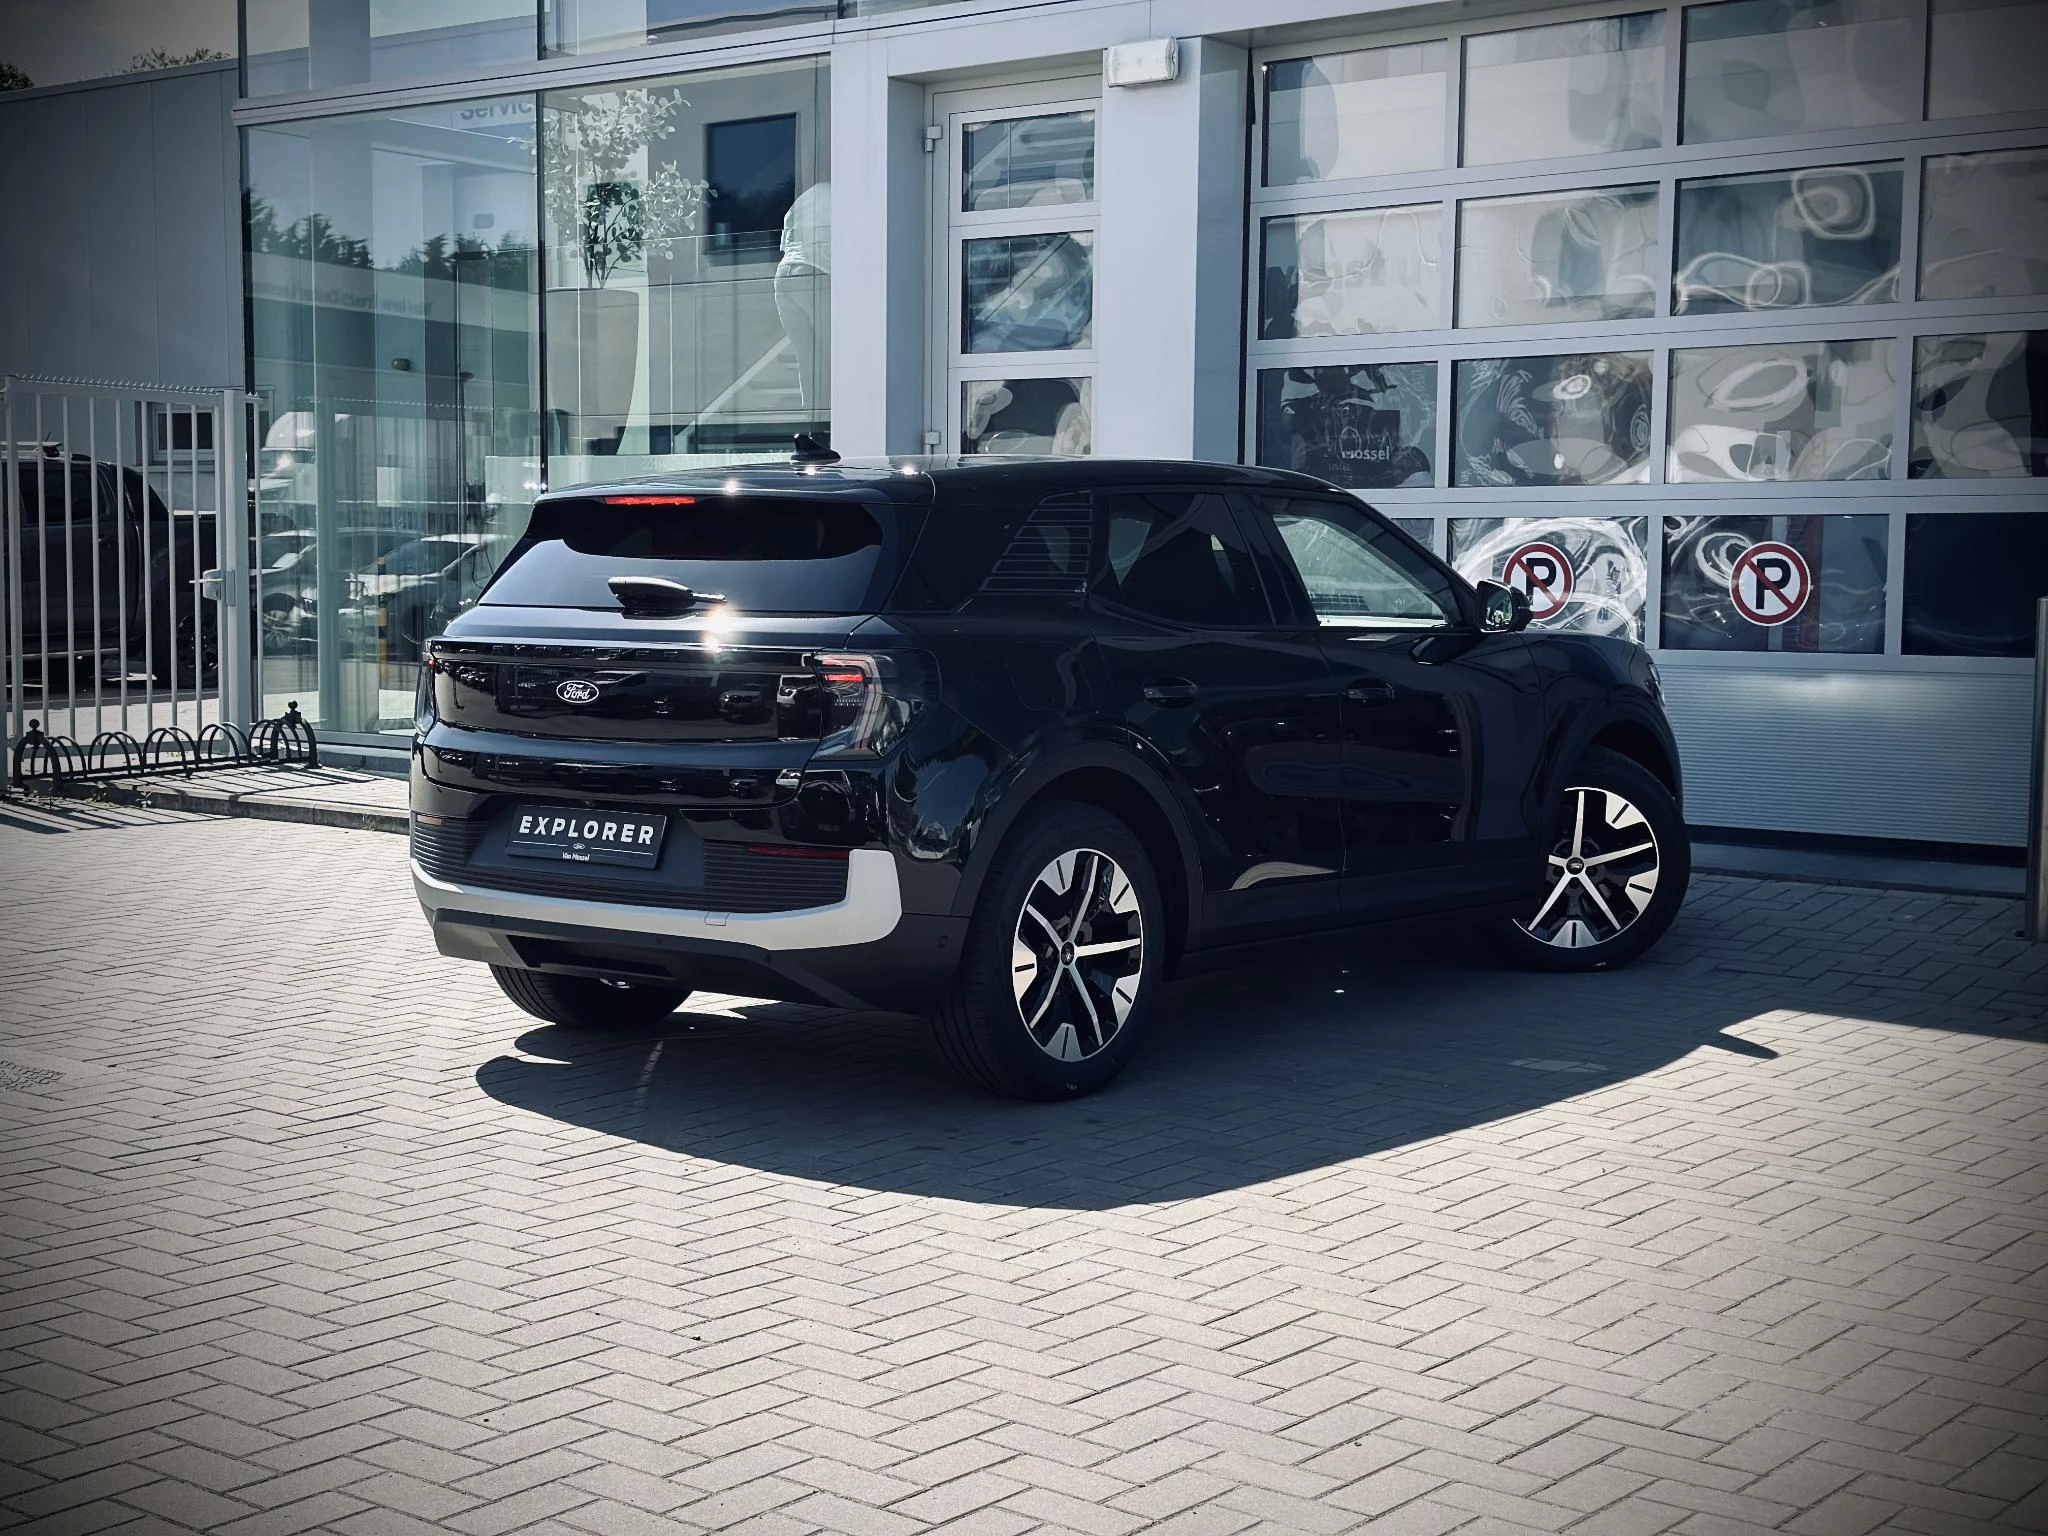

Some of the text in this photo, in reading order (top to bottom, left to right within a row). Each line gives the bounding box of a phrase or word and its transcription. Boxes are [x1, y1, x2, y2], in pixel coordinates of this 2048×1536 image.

[1525, 557, 1557, 605] P
[1755, 557, 1792, 610] P
[519, 815, 654, 845] EXPLORER
